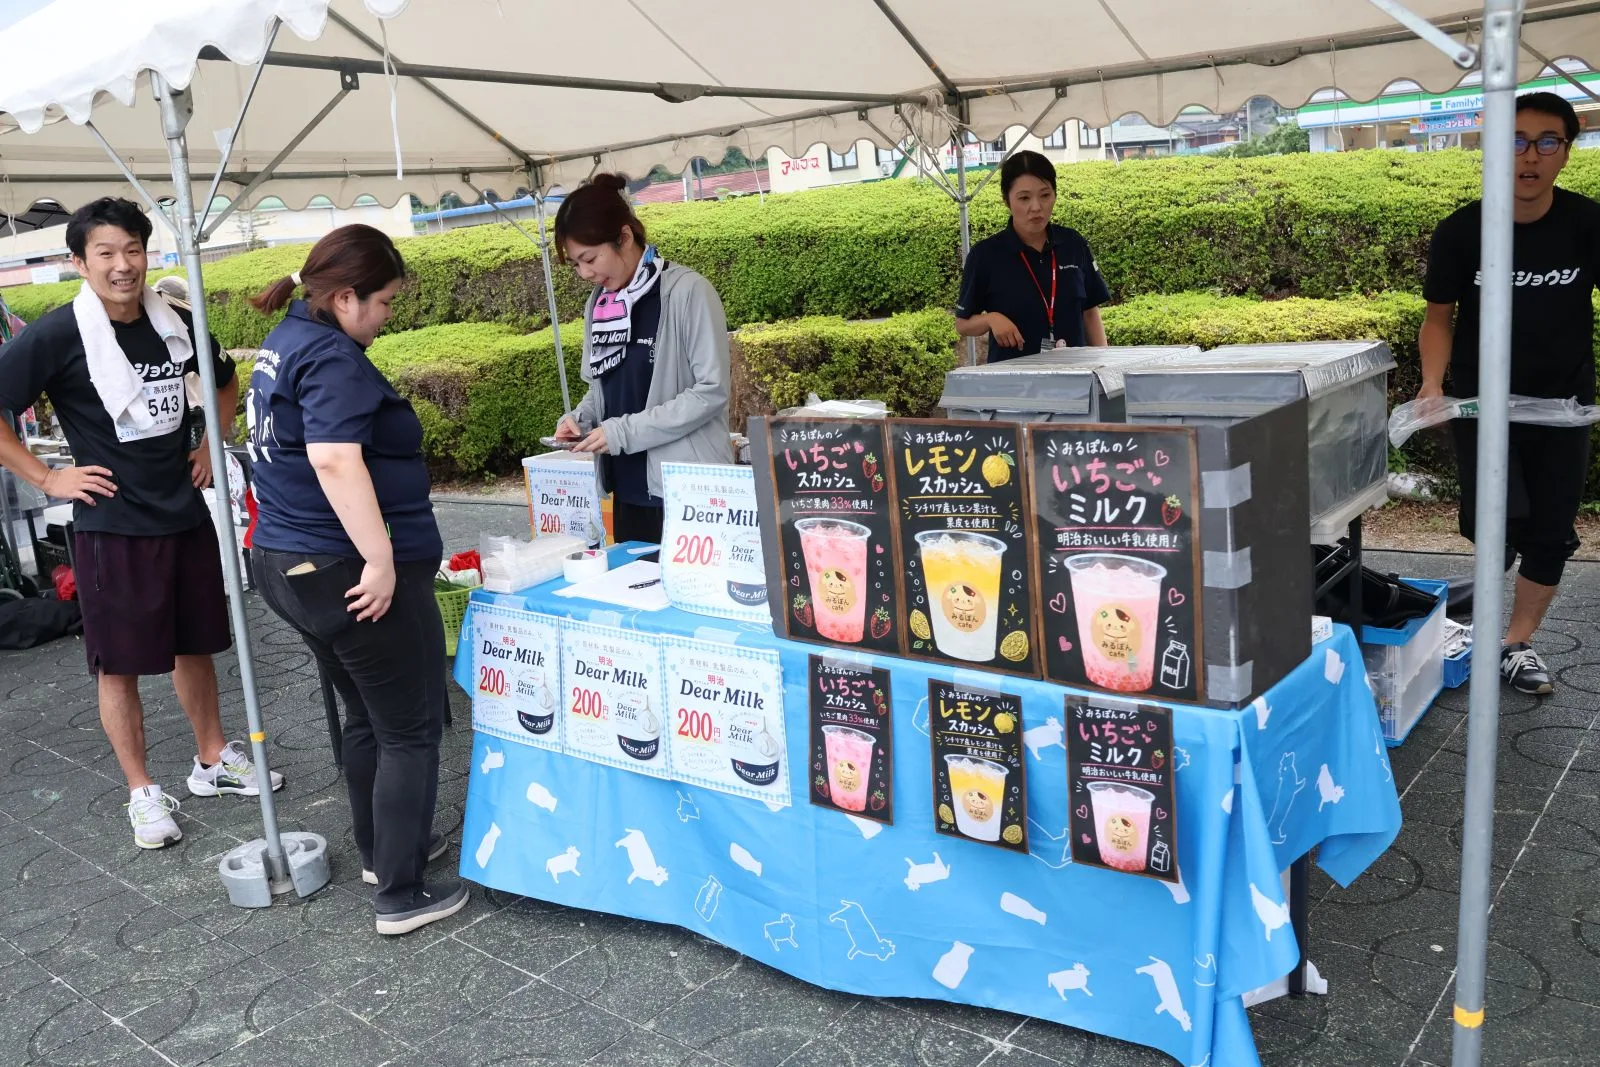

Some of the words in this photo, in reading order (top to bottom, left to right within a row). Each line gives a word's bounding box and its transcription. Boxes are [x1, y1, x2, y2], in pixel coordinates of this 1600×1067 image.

[1446, 97, 1484, 108] FamilyM
[608, 332, 626, 343] Man
[148, 395, 179, 416] 543
[791, 429, 832, 440] みるぽんの
[916, 431, 962, 444] みるぽんの
[1062, 439, 1122, 455] みるぽんの
[785, 442, 850, 471] いちご
[905, 446, 976, 475] レモン
[797, 472, 855, 488] スカッシュ
[1052, 458, 1144, 494] いちご
[919, 476, 984, 493] スカッシュ
[541, 494, 564, 506] Dear
[567, 496, 590, 508] Milk
[710, 498, 726, 508] 明治
[792, 497, 873, 510] いちご果肉33%使用!
[915, 502, 997, 514] シチリア産レモン果汁と
[1070, 494, 1146, 524] ミルク
[682, 505, 723, 524] Dear
[947, 517, 995, 528] 果皮を使用!
[1057, 532, 1178, 548] 明治おいしい牛乳使用!
[731, 584, 750, 598] Dear
[751, 588, 767, 599] Mil
[503, 636, 515, 646] 明治
[483, 640, 512, 660] Dear
[514, 648, 544, 667] Milk
[599, 656, 612, 666] 明治
[575, 660, 609, 680] Dear
[612, 668, 648, 689] Milk
[708, 675, 724, 686] 明治
[680, 679, 721, 701] Dear
[723, 687, 764, 710] Milk
[820, 677, 865, 696] いちご
[826, 694, 867, 710] スカッシュ
[940, 700, 990, 721] レモン
[1086, 709, 1126, 720] みるぽんの
[520, 714, 535, 727] Dear
[536, 719, 550, 728] Milk
[948, 720, 994, 736] スカッシュ
[1079, 721, 1140, 745] いちご
[621, 739, 638, 753] Dear
[639, 744, 656, 754] Milk
[1090, 742, 1142, 766] ミルク
[736, 762, 756, 779] Dear
[756, 768, 775, 779] Milk
[1082, 767, 1163, 783] 明治おいしい牛乳使用!
